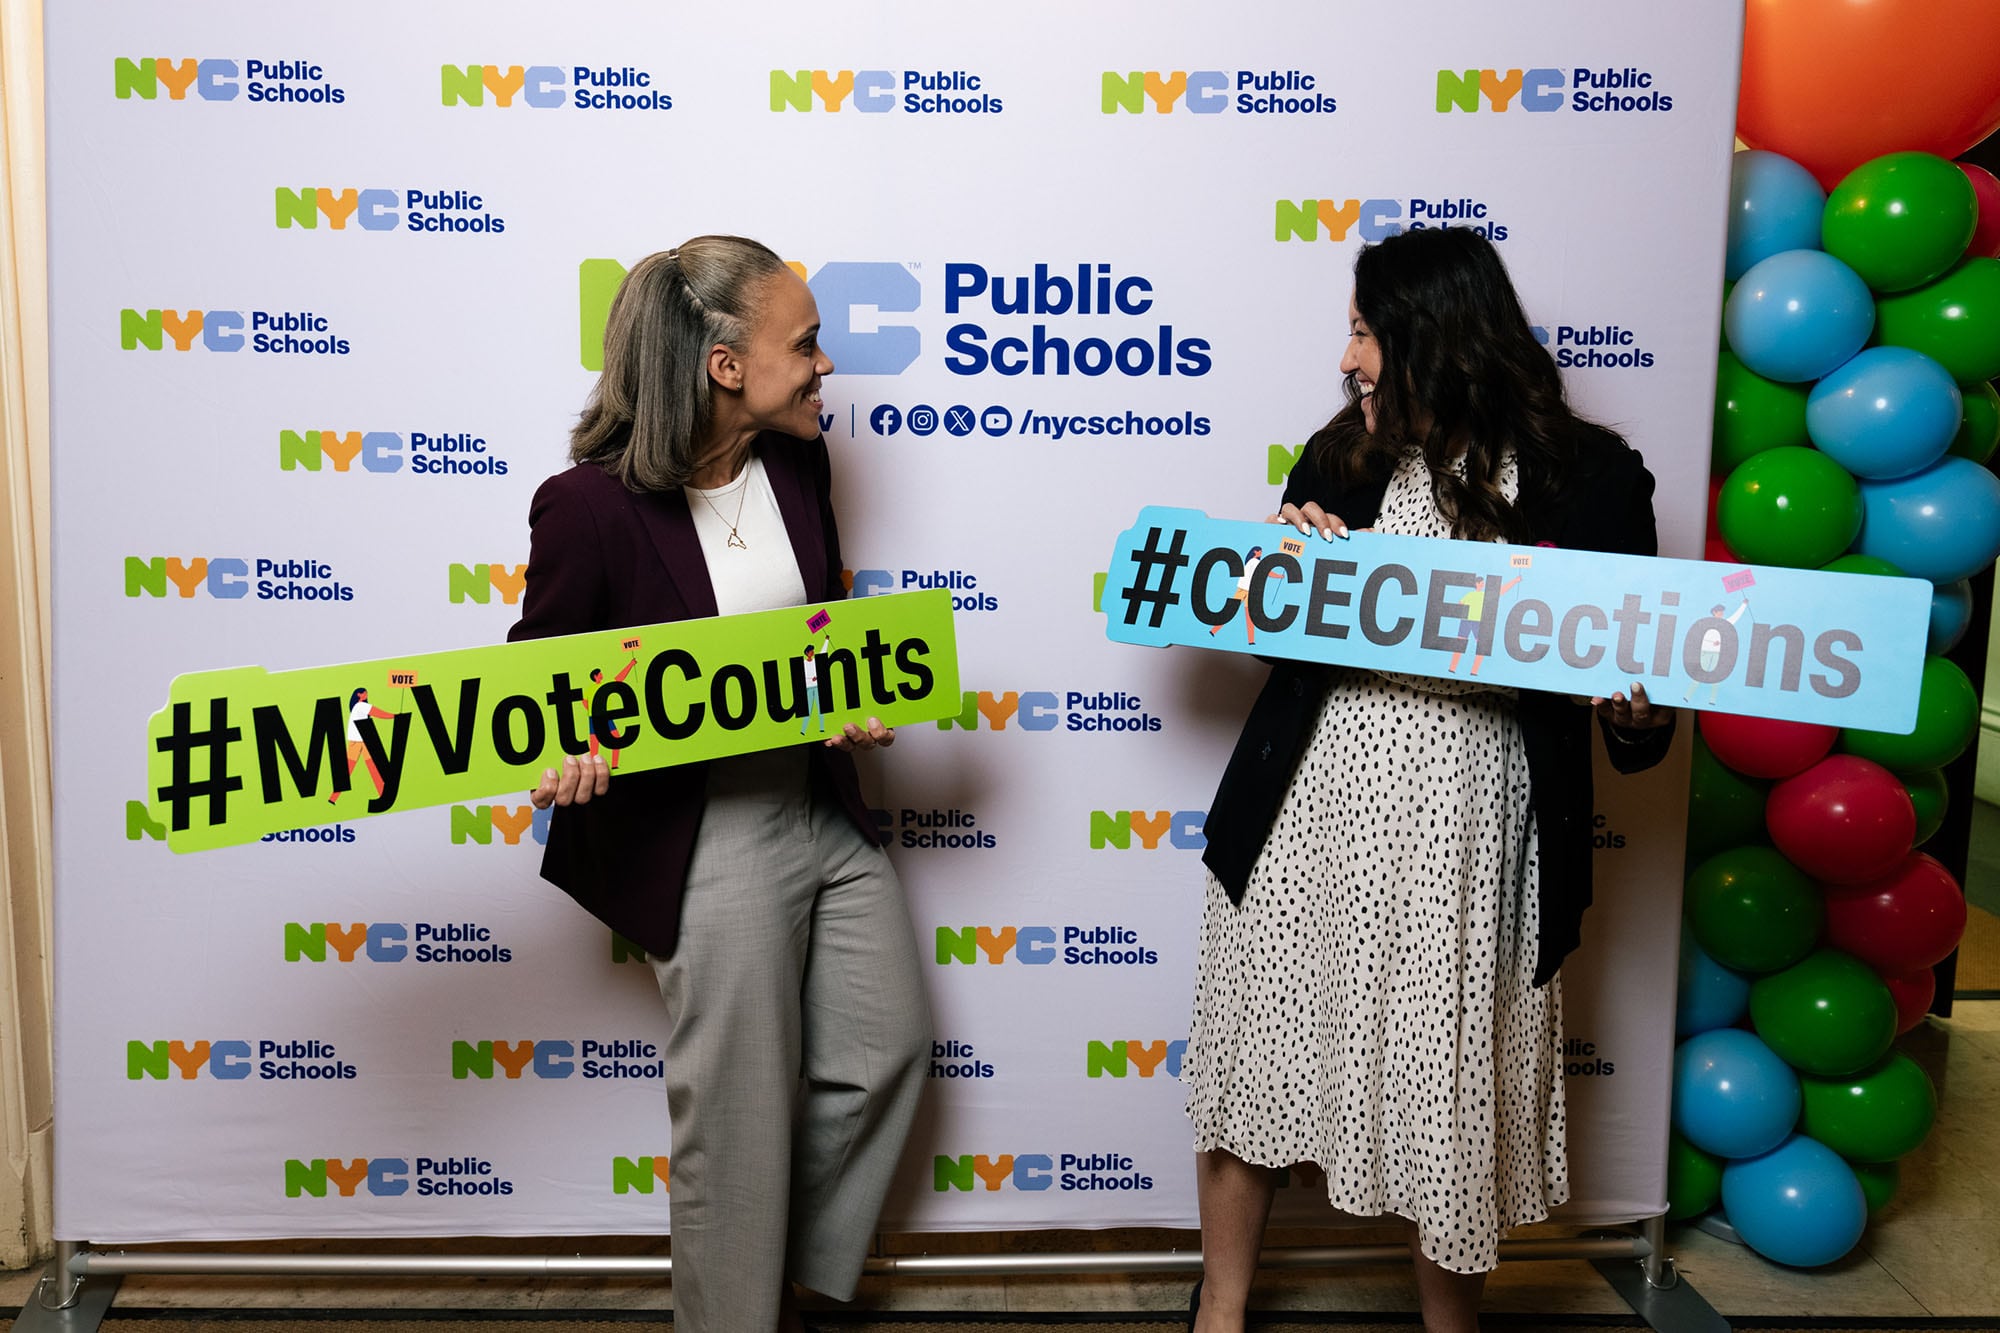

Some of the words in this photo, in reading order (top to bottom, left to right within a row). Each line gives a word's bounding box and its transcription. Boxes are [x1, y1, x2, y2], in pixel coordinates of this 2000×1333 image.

[114, 57, 240, 100] NYC
[246, 60, 323, 81] Public
[573, 66, 650, 88] Public
[904, 70, 981, 92] Public
[1237, 70, 1315, 91] Public
[1572, 67, 1652, 90] Public
[247, 82, 345, 104] Schools
[441, 64, 566, 108] NYC
[770, 69, 896, 113] NYC
[1101, 71, 1229, 114] NYC
[1436, 68, 1565, 113] NYC
[574, 89, 672, 111] Schools
[904, 93, 1003, 115] Schools
[1237, 93, 1337, 115] Schools
[1572, 90, 1672, 113] Schools
[275, 187, 400, 231] NYC
[406, 189, 483, 211] Public
[1410, 199, 1487, 220] Public
[407, 212, 505, 234] Schools
[1275, 199, 1402, 242] NYC
[944, 262, 1153, 315] Public
[120, 308, 245, 352] NYC
[252, 310, 328, 333] Public
[252, 334, 350, 355] Schools
[1557, 326, 1633, 346] Public
[943, 324, 1212, 376] Schools
[1556, 348, 1654, 368] Schools
[1019, 408, 1212, 440] /nycschools
[280, 429, 403, 473] NYC
[410, 432, 486, 454] Public
[411, 455, 508, 476] Schools
[1283, 541, 1302, 553] VOTE
[256, 559, 332, 580] Public
[1513, 557, 1530, 566] VOTE
[125, 556, 249, 599] NYC
[449, 564, 528, 604] NY
[902, 570, 977, 589] Public
[256, 581, 354, 601] Schools
[952, 592, 998, 611] ools
[810, 614, 829, 630] VOTE
[1121, 527, 1863, 699] #CCECElections
[623, 639, 640, 649] VOTE
[392, 674, 414, 685] VOTE
[1067, 693, 1140, 710] Public
[156, 629, 934, 832] #MyVoteCounts
[1066, 714, 1162, 732] Schools
[901, 809, 975, 828] Public
[901, 831, 996, 849] Schools
[1090, 810, 1208, 849] NYC
[284, 922, 407, 962] NYC
[415, 923, 490, 943] Public
[1064, 926, 1137, 945] Public
[415, 944, 512, 963] Schools
[936, 926, 1056, 965] NYC
[1064, 946, 1158, 965] Schools
[127, 1039, 251, 1080] NYC
[259, 1040, 335, 1060] Public
[452, 1039, 574, 1079] NYC
[582, 1040, 656, 1058] Public
[931, 1040, 974, 1058] blic
[259, 1061, 357, 1081] Schools
[582, 1060, 664, 1078] School
[929, 1061, 994, 1078] hools
[1563, 1058, 1615, 1076] ools
[416, 1157, 491, 1176] Public
[934, 1154, 1053, 1192] NYC
[1060, 1154, 1133, 1172] Public
[285, 1158, 408, 1197] NYC
[416, 1177, 513, 1196] Schools
[1060, 1173, 1153, 1191] Schools
